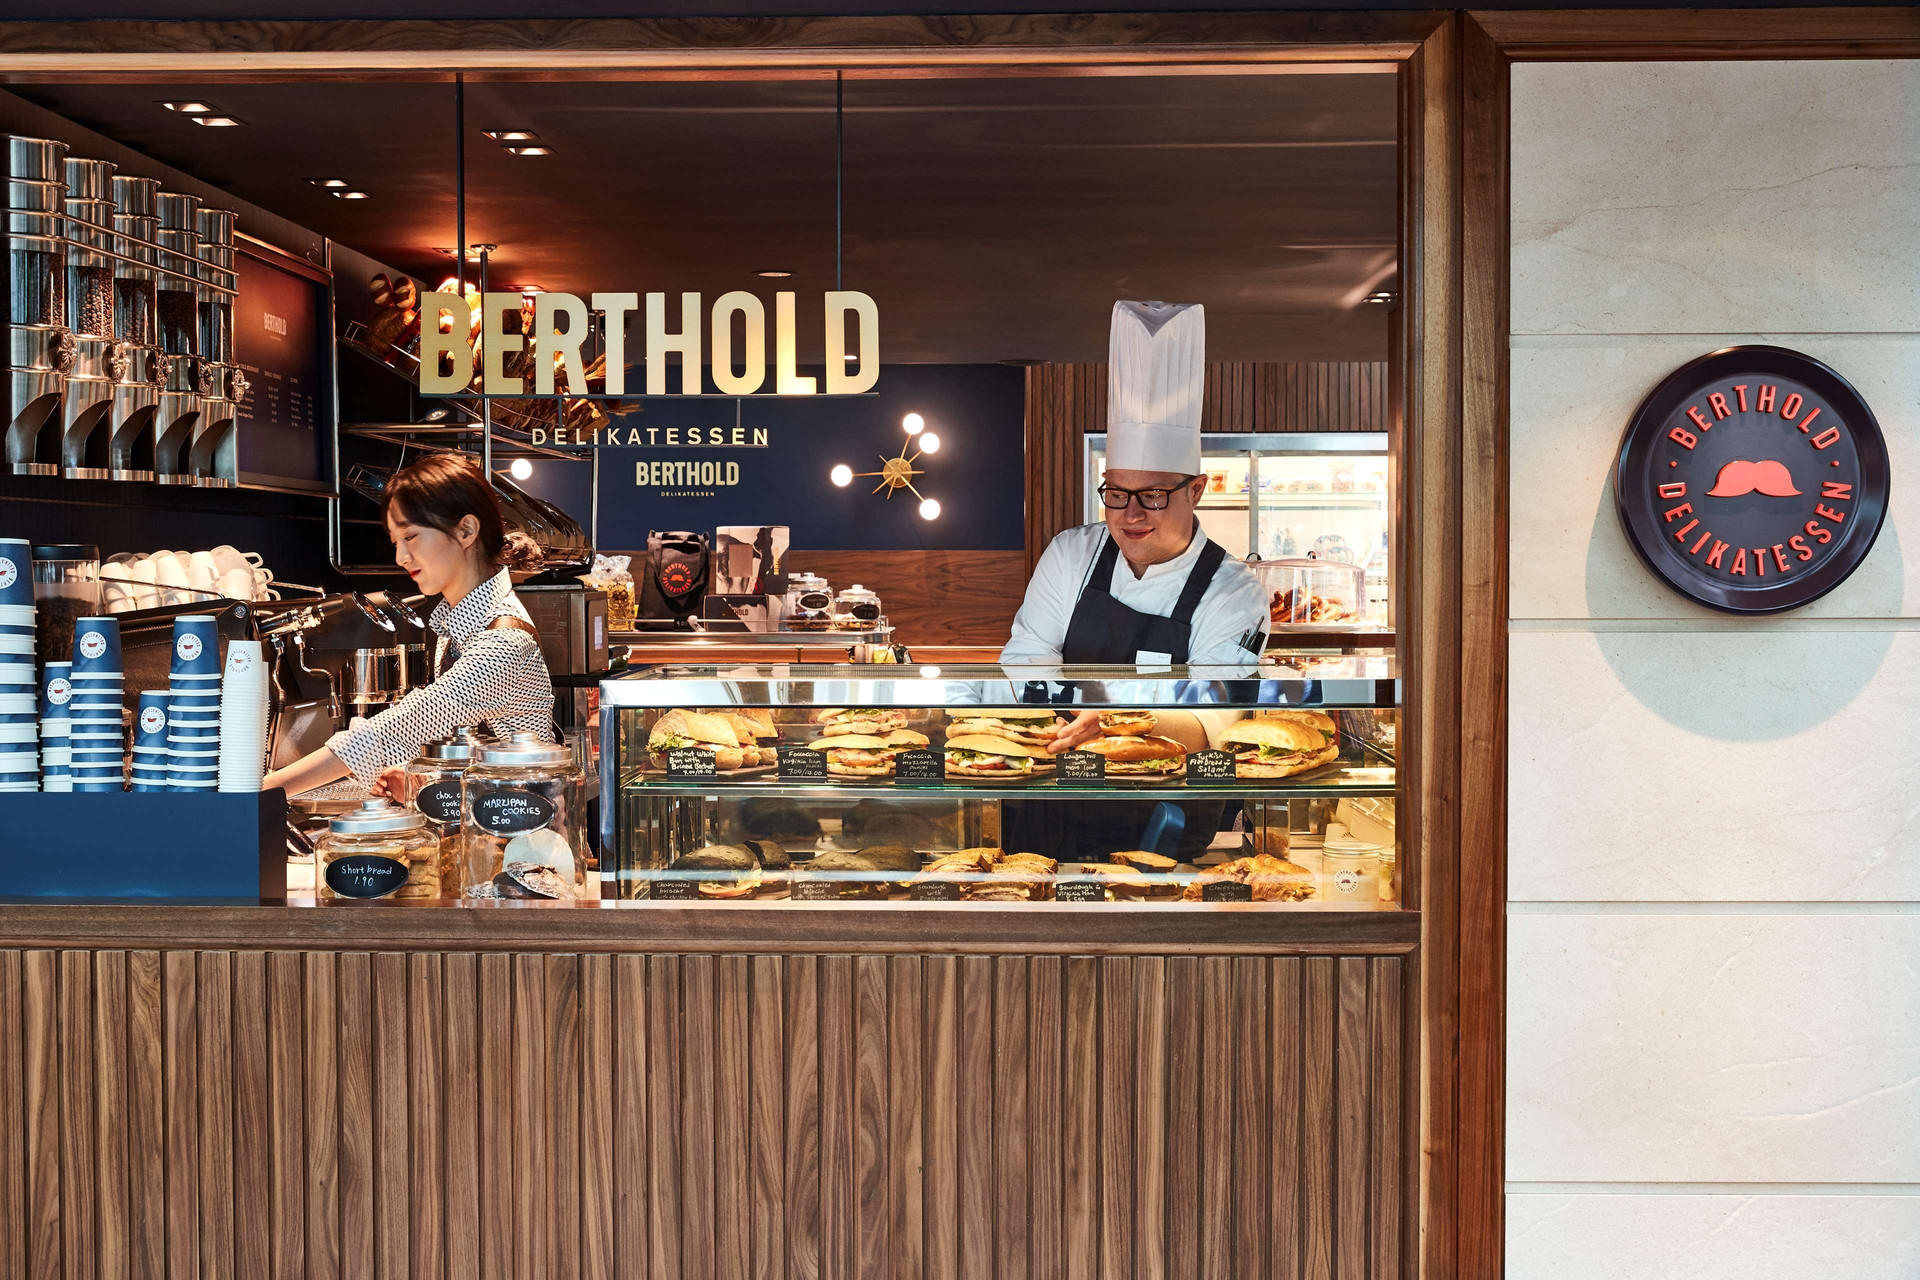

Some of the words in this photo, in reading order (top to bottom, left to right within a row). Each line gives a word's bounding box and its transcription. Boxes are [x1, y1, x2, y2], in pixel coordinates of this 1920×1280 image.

[419, 290, 880, 396] BERTHOLD
[1668, 384, 1841, 451] BERTHOLD
[532, 427, 770, 445] DELIKATESSEN
[636, 461, 740, 486] BERTHOLD
[1657, 481, 1853, 576] DELIKATESSEN
[1196, 752, 1224, 760] Turkish
[435, 790, 453, 800] choc
[483, 798, 528, 808] MARZIPAN
[442, 808, 461, 817] 3.90
[502, 807, 541, 816] COOKIES
[491, 815, 511, 825] 5.00
[354, 876, 375, 887] 1.90
